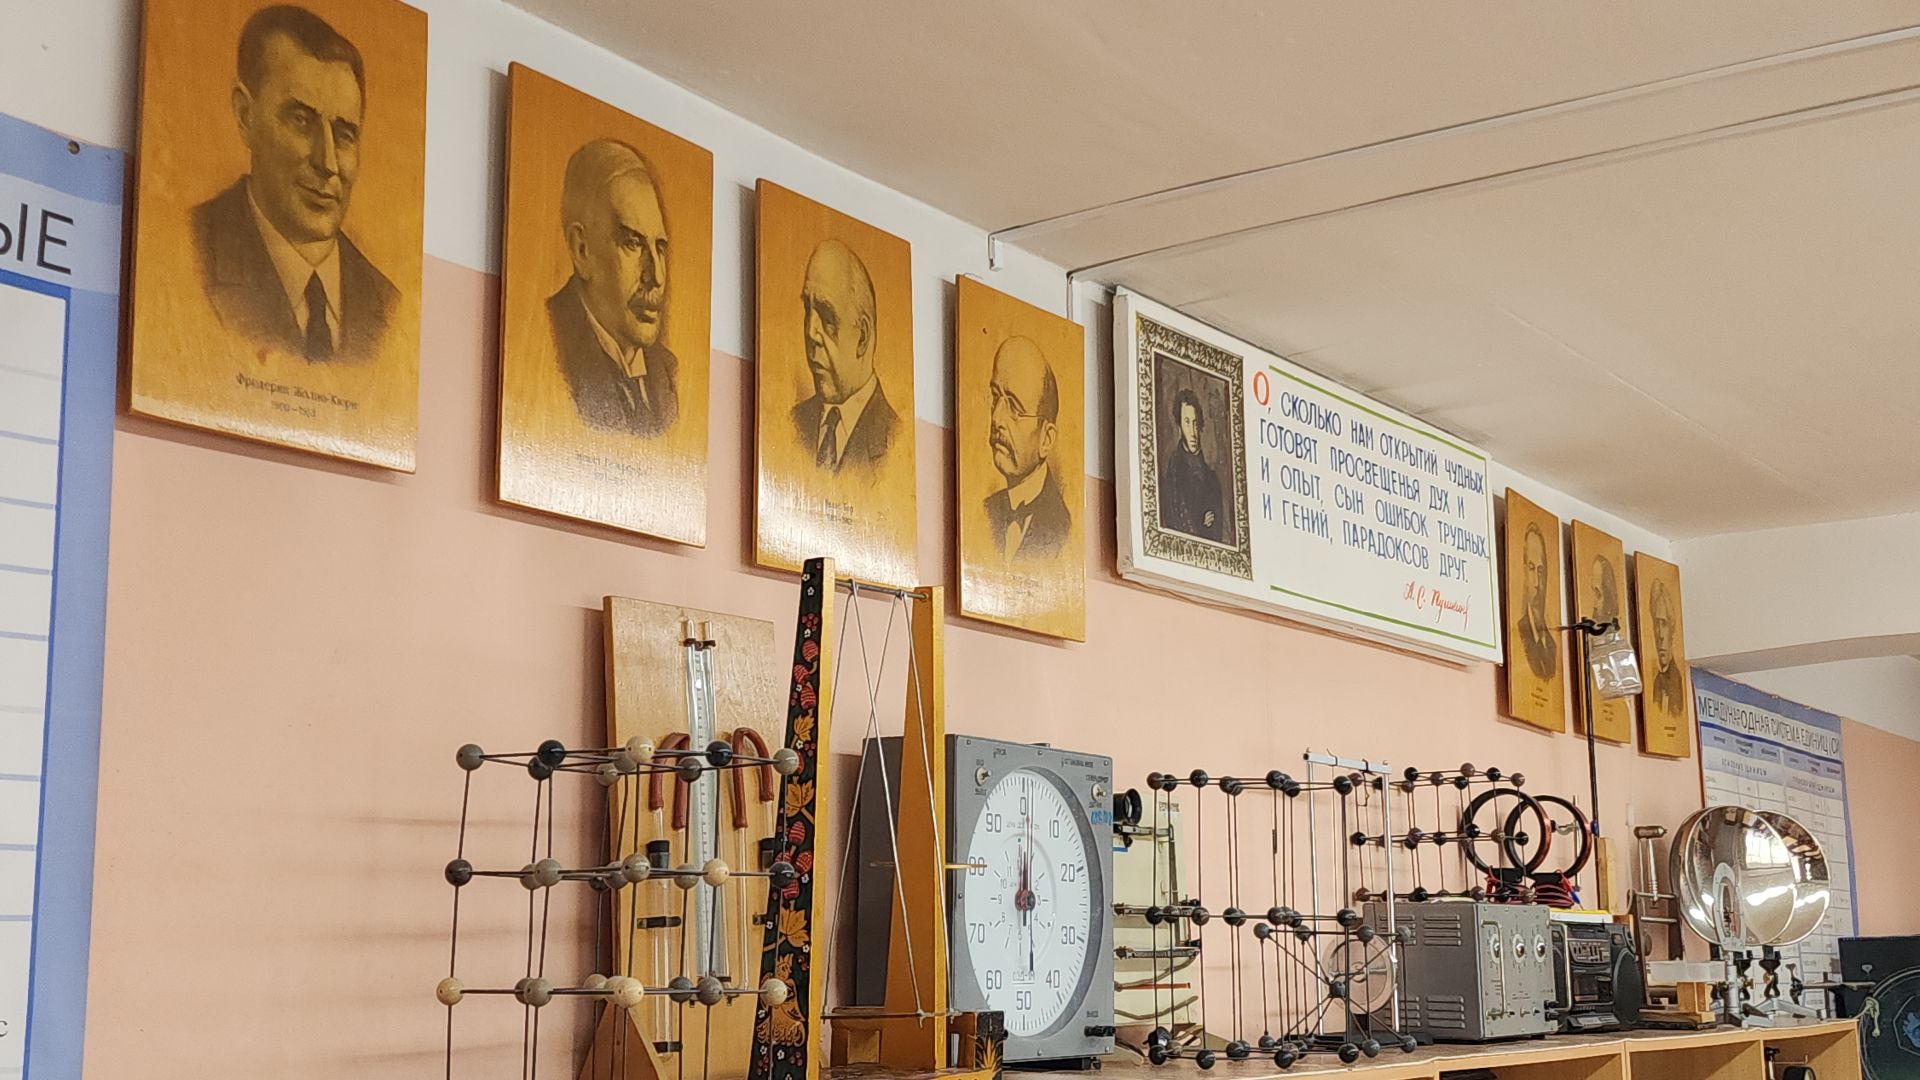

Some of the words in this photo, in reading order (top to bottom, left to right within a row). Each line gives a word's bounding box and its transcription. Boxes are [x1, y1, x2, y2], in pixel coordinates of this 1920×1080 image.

[1253, 371, 1271, 414] О,
[1281, 391, 1342, 437] СКОЛЬКО
[1351, 419, 1373, 451] НАМ
[1380, 432, 1438, 477] ОТКРЫТИЙ
[1444, 458, 1484, 495] ЧУДНЫХ
[1260, 418, 1318, 465] ГОТОВЯТ
[1330, 446, 1420, 502] ПРОСВЕЩЕНЬЯ
[1429, 485, 1450, 514] ДУХ
[1457, 496, 1465, 520] И
[1260, 455, 1270, 483] И
[1280, 465, 1323, 506] ОПЫТ,
[1334, 483, 1364, 516] СЫН
[1375, 499, 1428, 538] ОШИБОК
[1437, 520, 1490, 562] ТРУДНЫХ,
[1262, 493, 1272, 521] И
[1282, 500, 1333, 545] ГЕНИЙ,
[1343, 520, 1429, 570] ПАРАДОКСОВ
[1439, 552, 1469, 584] ДРУГ.
[1698, 695, 1770, 734] МЕЖДУНАРОДНАЯ
[1770, 717, 1800, 745] СИСТЕМА
[1020, 796, 1027, 816] 0
[986, 813, 1002, 833] 90
[1049, 818, 1060, 838] 10
[1061, 863, 1075, 882] 20
[969, 923, 985, 943] 70
[1061, 926, 1075, 945] 30
[986, 970, 1002, 990] 60
[1045, 969, 1060, 989] 40
[1016, 990, 1031, 1010] 50
